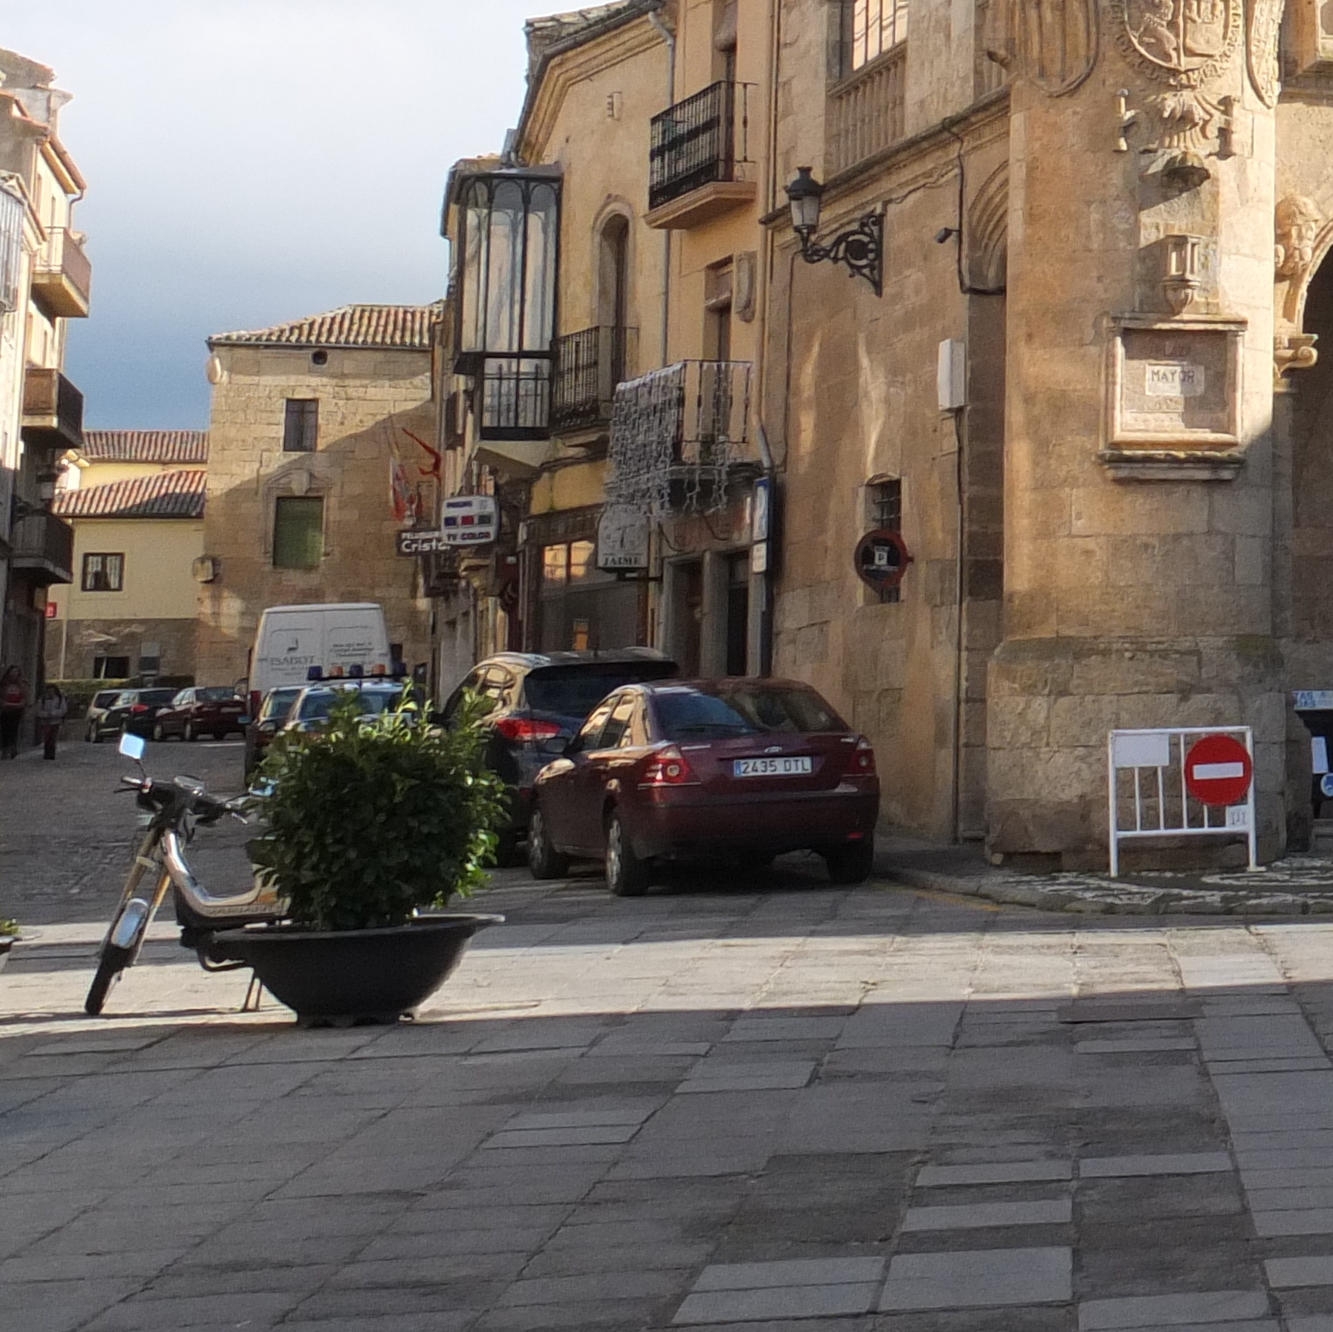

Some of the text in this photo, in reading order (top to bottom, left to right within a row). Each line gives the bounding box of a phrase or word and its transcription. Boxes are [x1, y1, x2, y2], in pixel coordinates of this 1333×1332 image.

[1151, 370, 1195, 383] MAYOR
[742, 758, 810, 775] 2435 DTL
